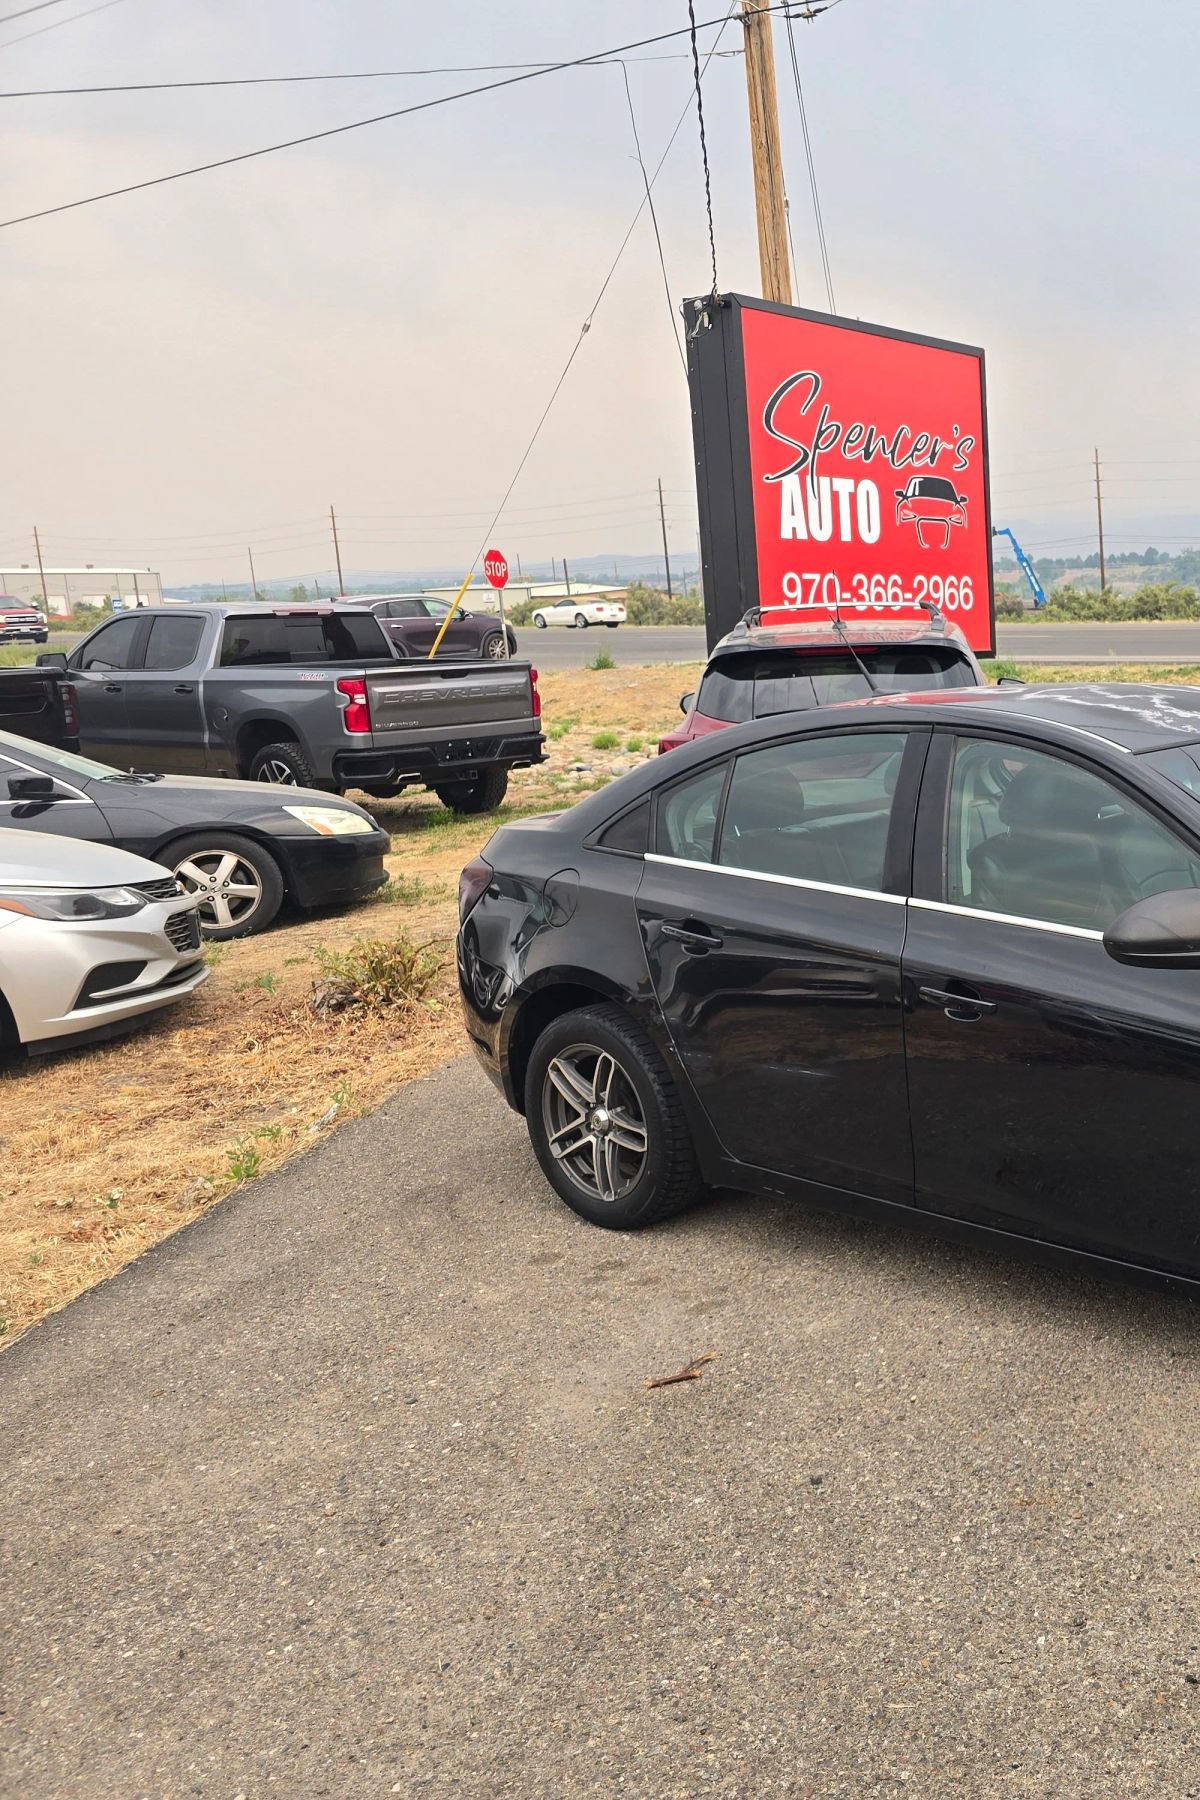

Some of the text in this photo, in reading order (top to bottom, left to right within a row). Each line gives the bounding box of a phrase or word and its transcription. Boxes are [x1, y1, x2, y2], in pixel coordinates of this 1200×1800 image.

[763, 370, 976, 500] Spencer's
[780, 474, 882, 544] AUTO
[485, 560, 506, 577] STOP
[782, 572, 974, 612] 970-366-2966
